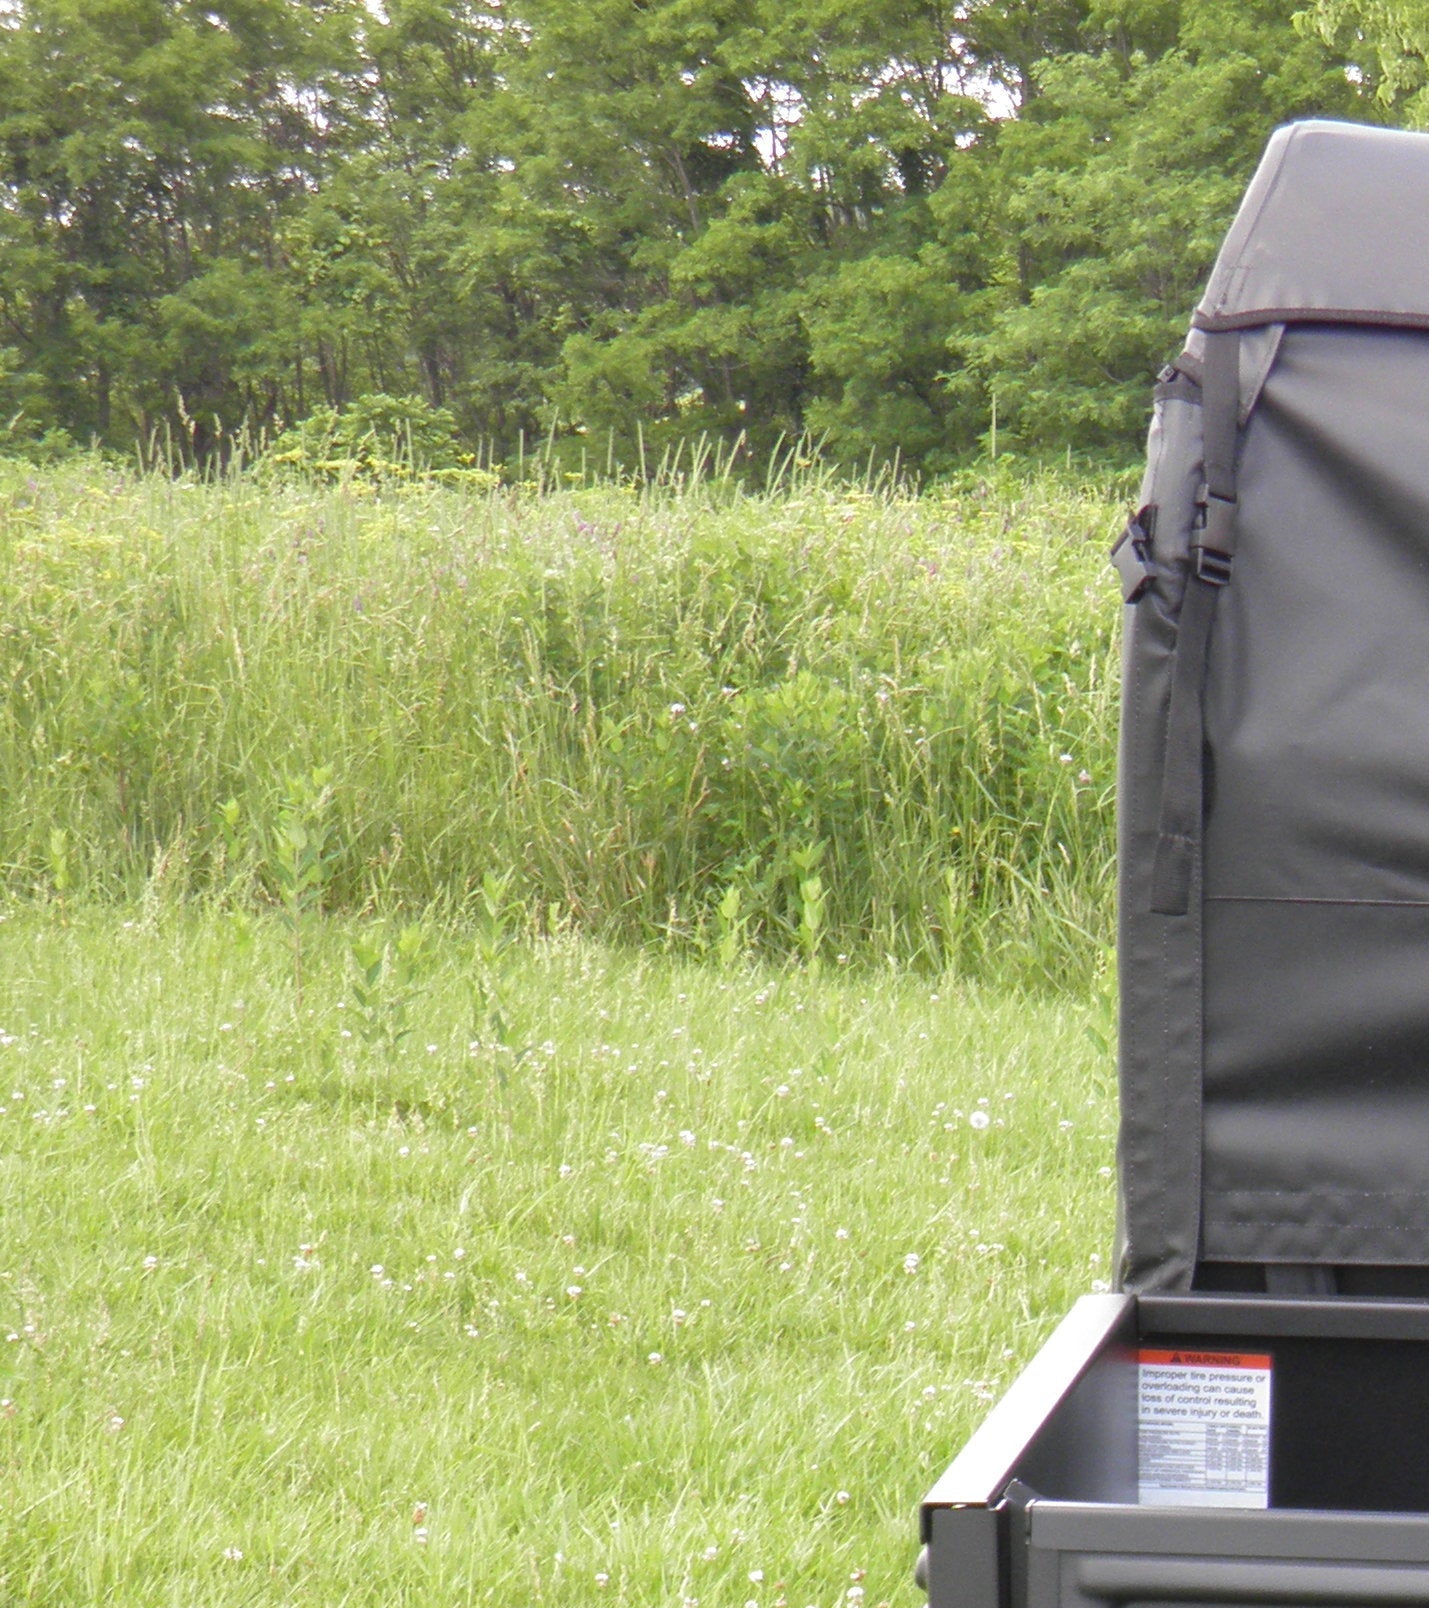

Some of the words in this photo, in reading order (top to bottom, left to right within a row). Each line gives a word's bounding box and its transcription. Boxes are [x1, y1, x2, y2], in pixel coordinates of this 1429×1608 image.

[1184, 1354, 1241, 1366] WARNING
[1142, 1368, 1187, 1380] Improper
[1190, 1371, 1207, 1380] tire
[1209, 1373, 1253, 1383] pressure
[1255, 1375, 1266, 1383] or
[1141, 1382, 1201, 1394] overloading
[1203, 1384, 1222, 1393] can
[1224, 1386, 1255, 1395] cause
[1141, 1393, 1162, 1403] loss
[1165, 1394, 1175, 1403] of
[1177, 1395, 1211, 1405] control
[1214, 1397, 1257, 1409] resulting
[1141, 1405, 1151, 1414] in
[1153, 1407, 1188, 1416] severe
[1190, 1407, 1218, 1420] injury
[1220, 1410, 1231, 1418] or
